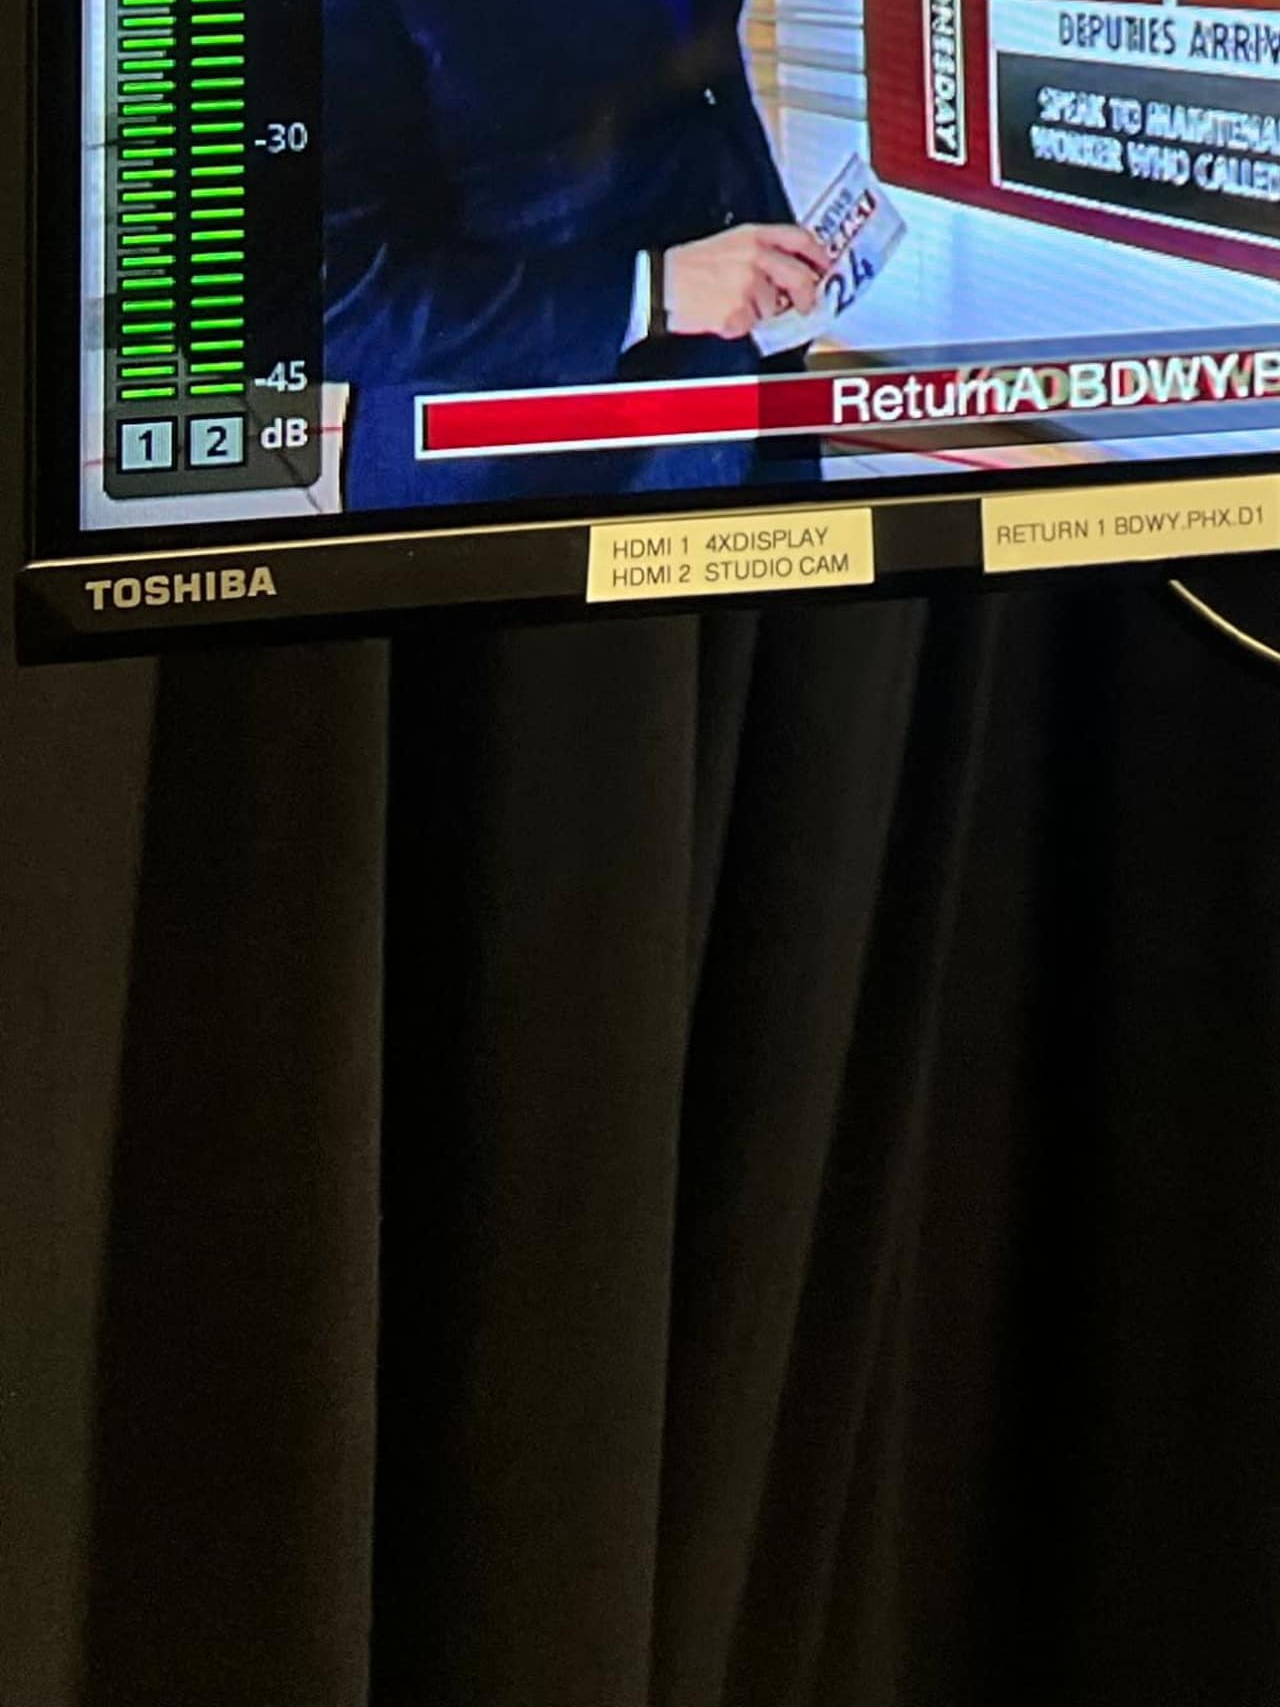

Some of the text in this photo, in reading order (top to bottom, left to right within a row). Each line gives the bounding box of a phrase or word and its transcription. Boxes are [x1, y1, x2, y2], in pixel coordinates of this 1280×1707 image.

[1059, 11, 1176, 56] DEPUTIES
[1108, 97, 1142, 136] TO
[253, 122, 308, 153] -30
[1126, 139, 1191, 186] WHO
[253, 361, 308, 393] -45
[832, 365, 1050, 424] ReturnA
[138, 417, 309, 462] 1 2 dB
[612, 527, 829, 559] HDMI 1 4XDISPLAY
[997, 505, 1264, 545] RETURN 1 BDWY.PHX.D1
[85, 565, 278, 612] TOSHIBA
[612, 553, 850, 587] HDMI 2 STUDIO CAM
